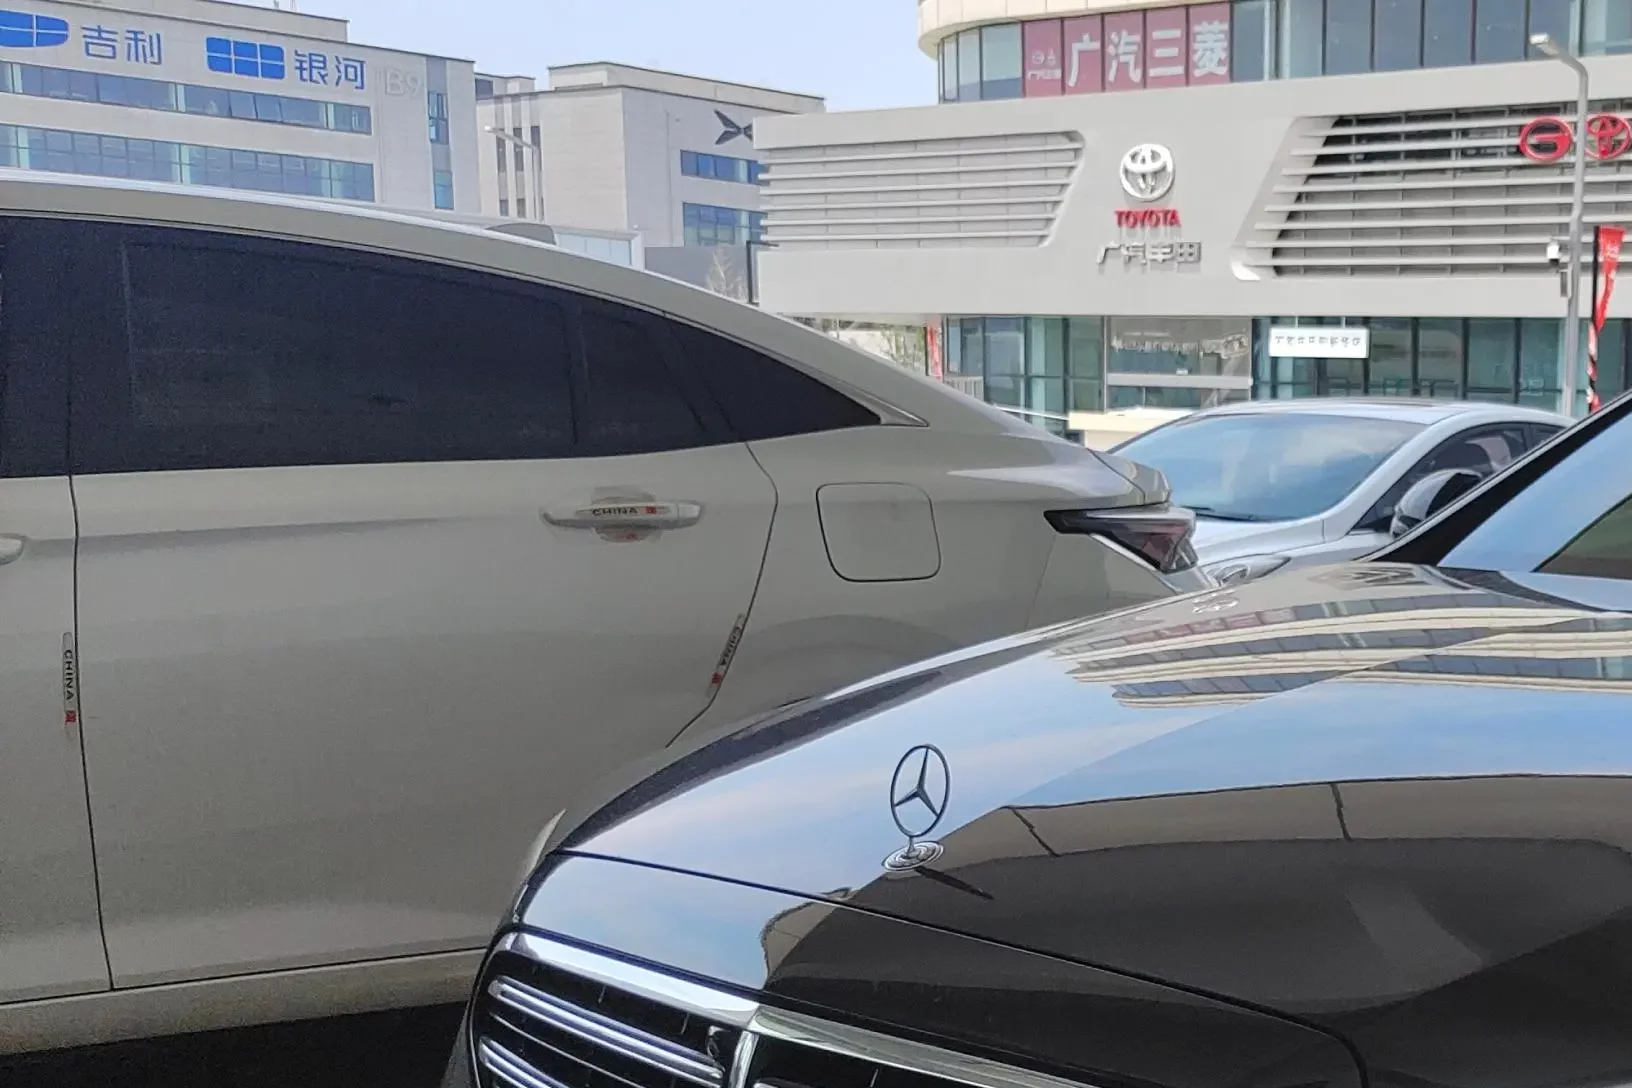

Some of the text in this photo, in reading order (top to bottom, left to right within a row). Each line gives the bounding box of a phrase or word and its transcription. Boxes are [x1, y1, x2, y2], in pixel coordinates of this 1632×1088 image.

[81, 24, 163, 66] 吉利
[1067, 20, 1229, 88] 广汽三菱
[293, 48, 366, 91] 银河
[1113, 207, 1181, 229] TOYOTA
[1096, 240, 1202, 265] 广汽丰田
[592, 506, 638, 517] CHINA
[63, 649, 75, 701] CHINA
